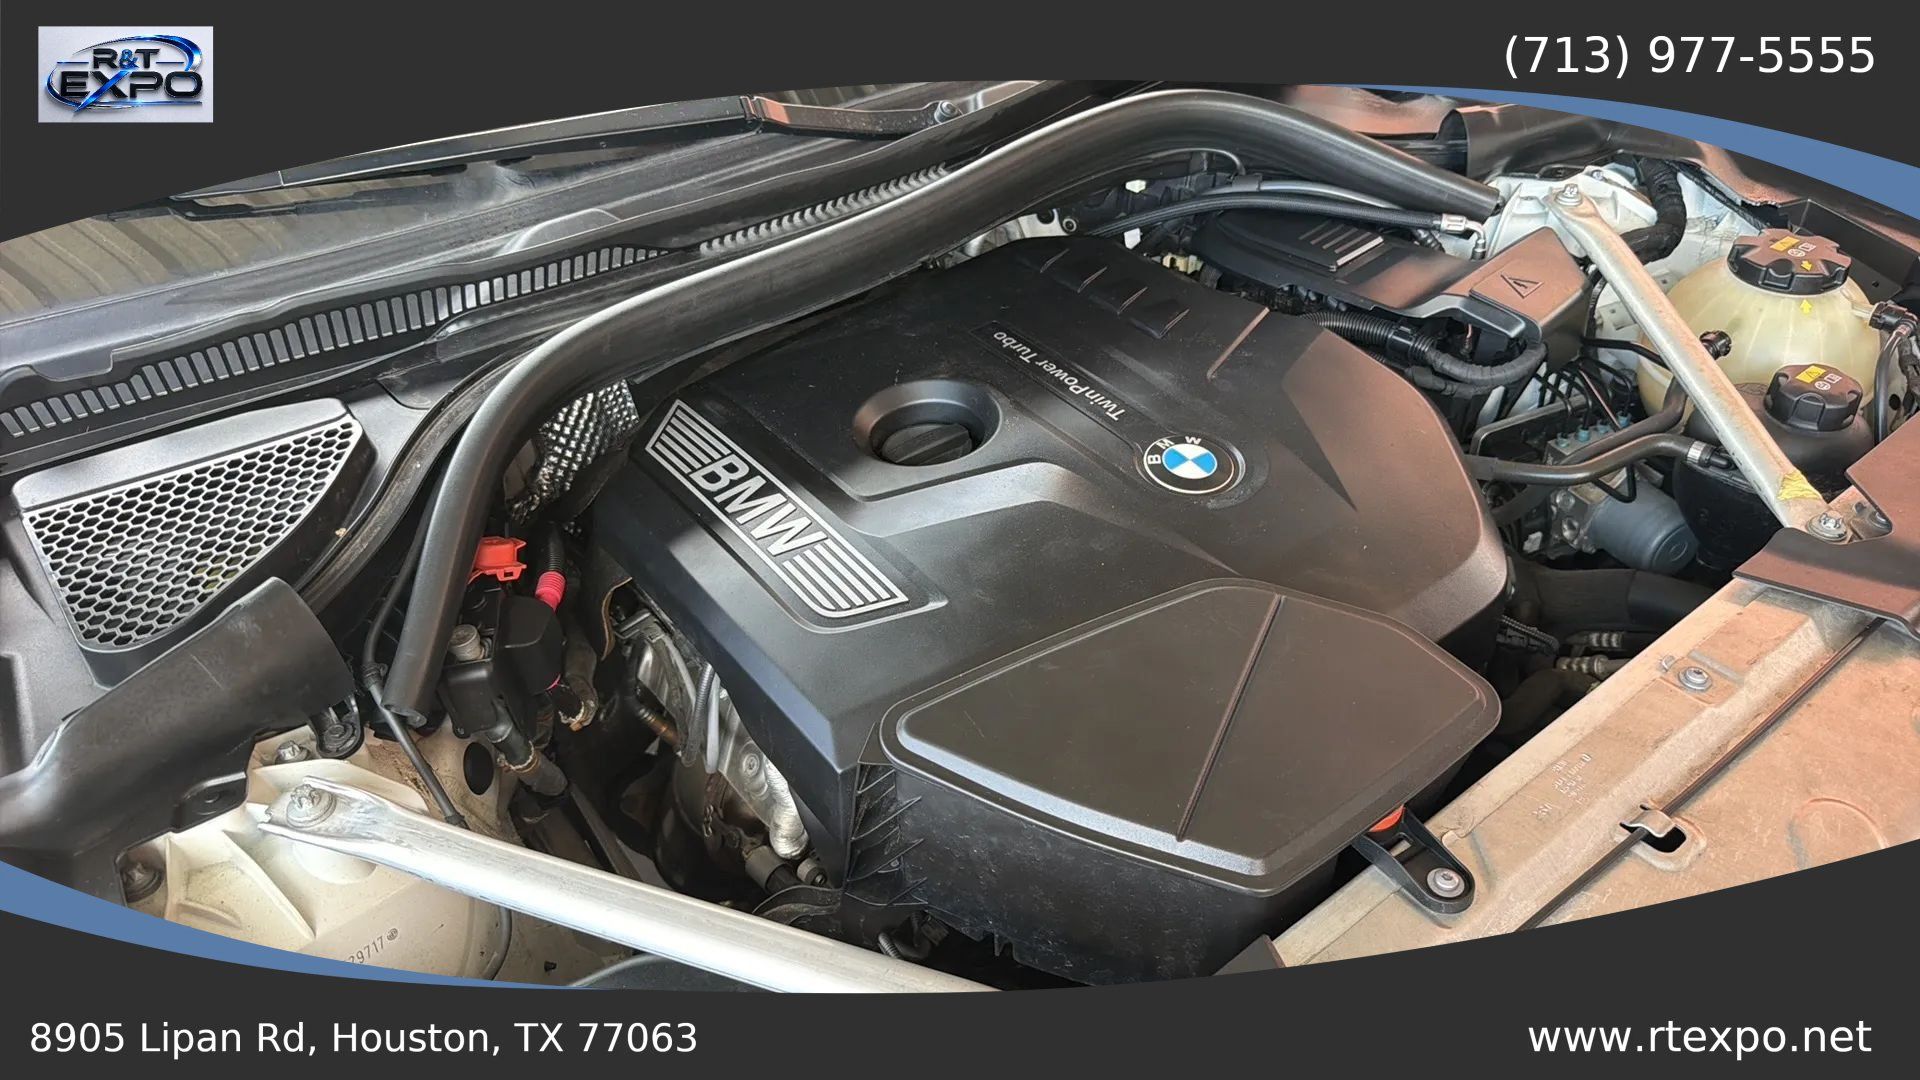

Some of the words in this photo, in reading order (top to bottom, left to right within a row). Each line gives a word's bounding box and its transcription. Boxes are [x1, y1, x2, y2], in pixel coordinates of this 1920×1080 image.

[993, 331, 1038, 364] Turbo
[1035, 359, 1126, 421] TwinPower
[1147, 435, 1202, 465] BMW
[689, 453, 829, 557] BMW
